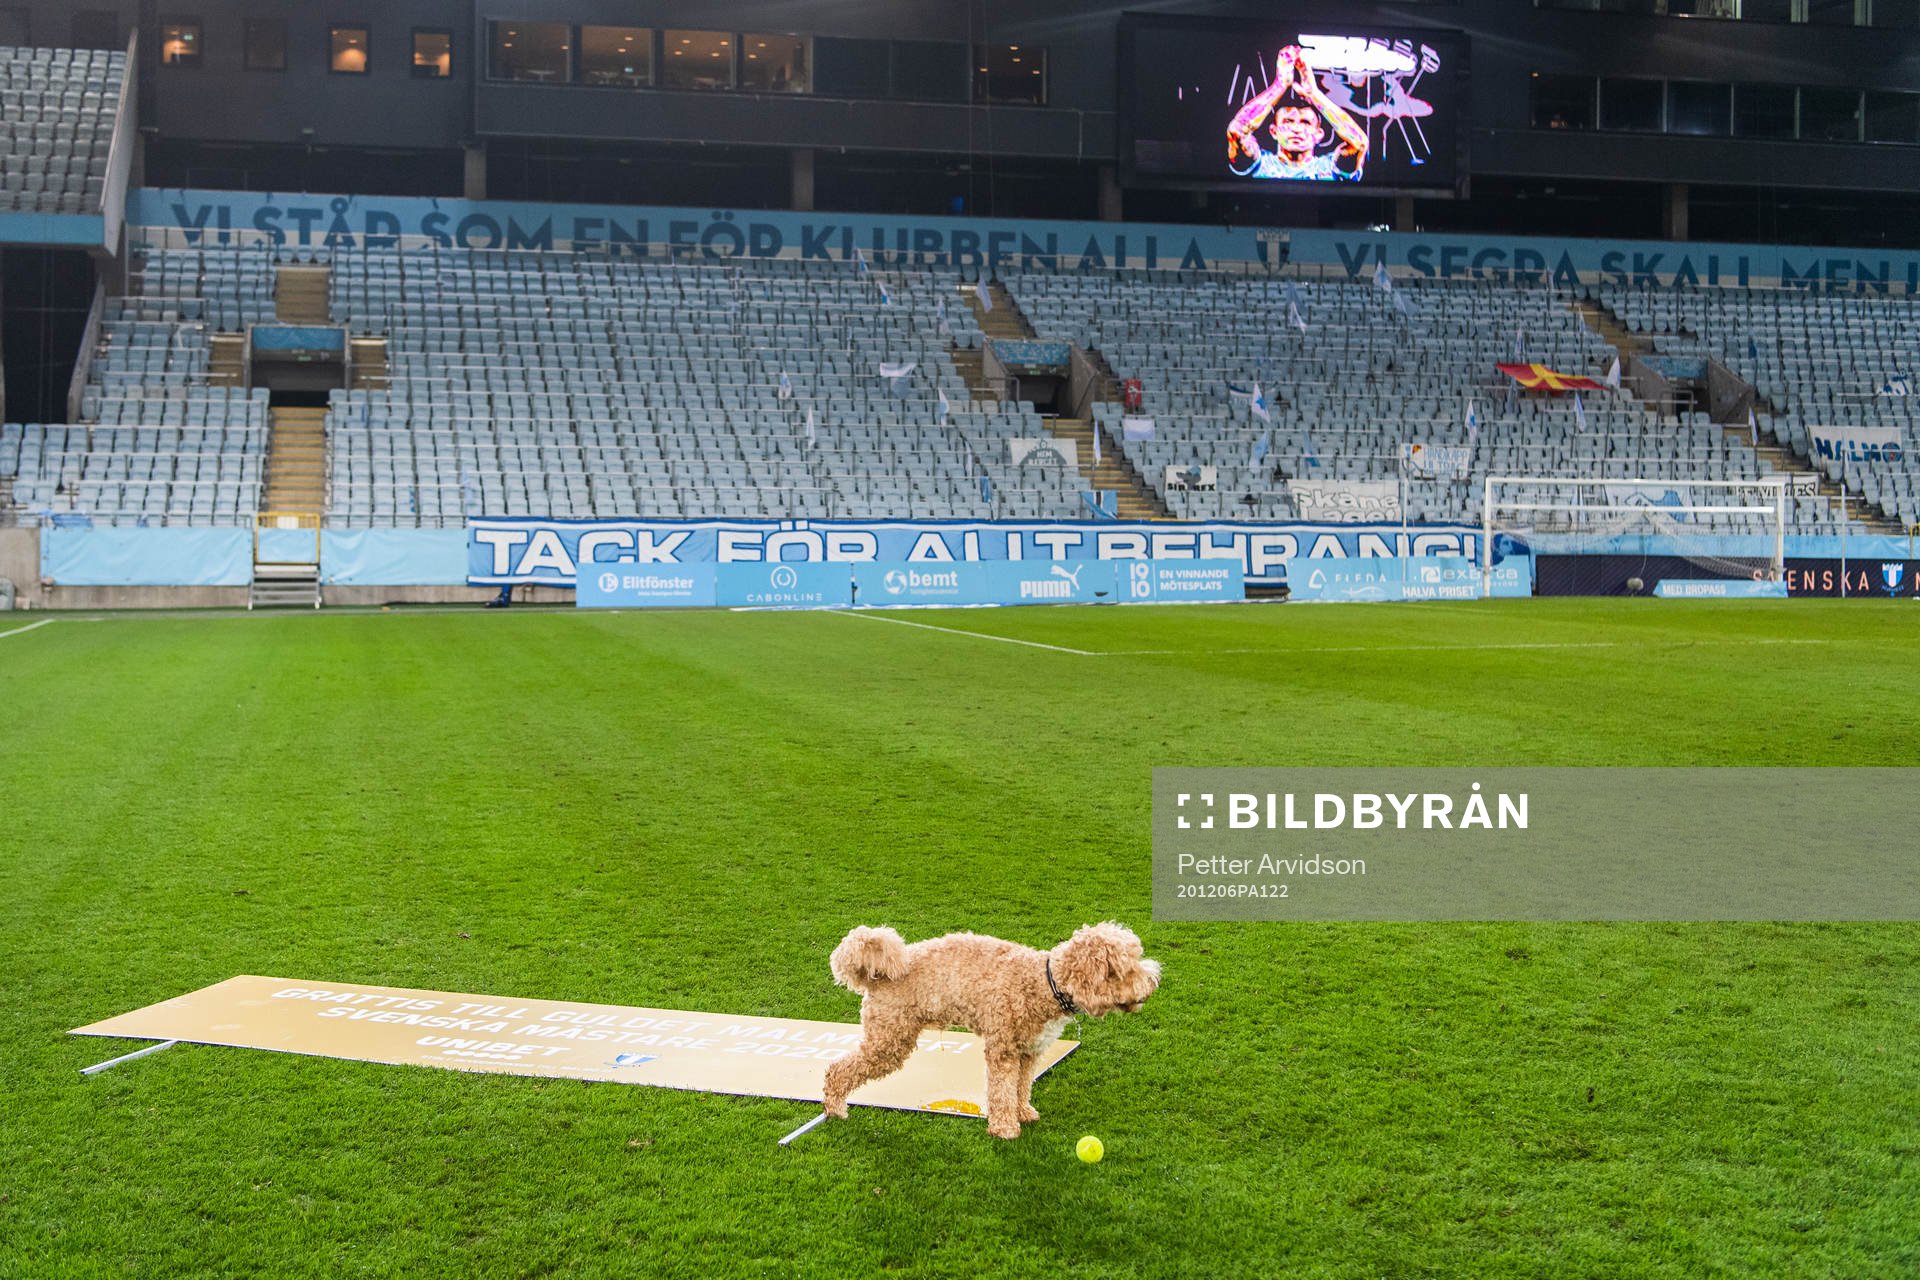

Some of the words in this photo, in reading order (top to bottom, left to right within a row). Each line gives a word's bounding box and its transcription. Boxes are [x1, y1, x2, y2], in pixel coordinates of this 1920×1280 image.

[171, 204, 231, 246] VI
[420, 212, 553, 250] SOM
[573, 217, 649, 256] EN
[1335, 243, 1387, 278] VI
[1782, 257, 1890, 293] MEN
[475, 529, 695, 576] TACK
[717, 520, 878, 561] FÖR
[623, 575, 694, 589] Elitfönster
[909, 570, 958, 587] bemt
[1160, 569, 1174, 579] EN
[1176, 569, 1229, 579] VINNANDE
[1020, 580, 1072, 598] PUMA
[1160, 579, 1222, 591] MÖTESPLATS
[1402, 586, 1437, 598] HALVA
[1439, 585, 1474, 597] PRISET
[747, 592, 823, 602] CABONLINE
[271, 988, 443, 1011] GRATTIS
[450, 1002, 528, 1020] TILL
[541, 1011, 713, 1034] GULDET
[718, 1024, 863, 1046] MALM
[317, 1007, 511, 1033] SVENSKA
[512, 1024, 720, 1050] MÄSTARE
[416, 1036, 571, 1056] UNIBET
